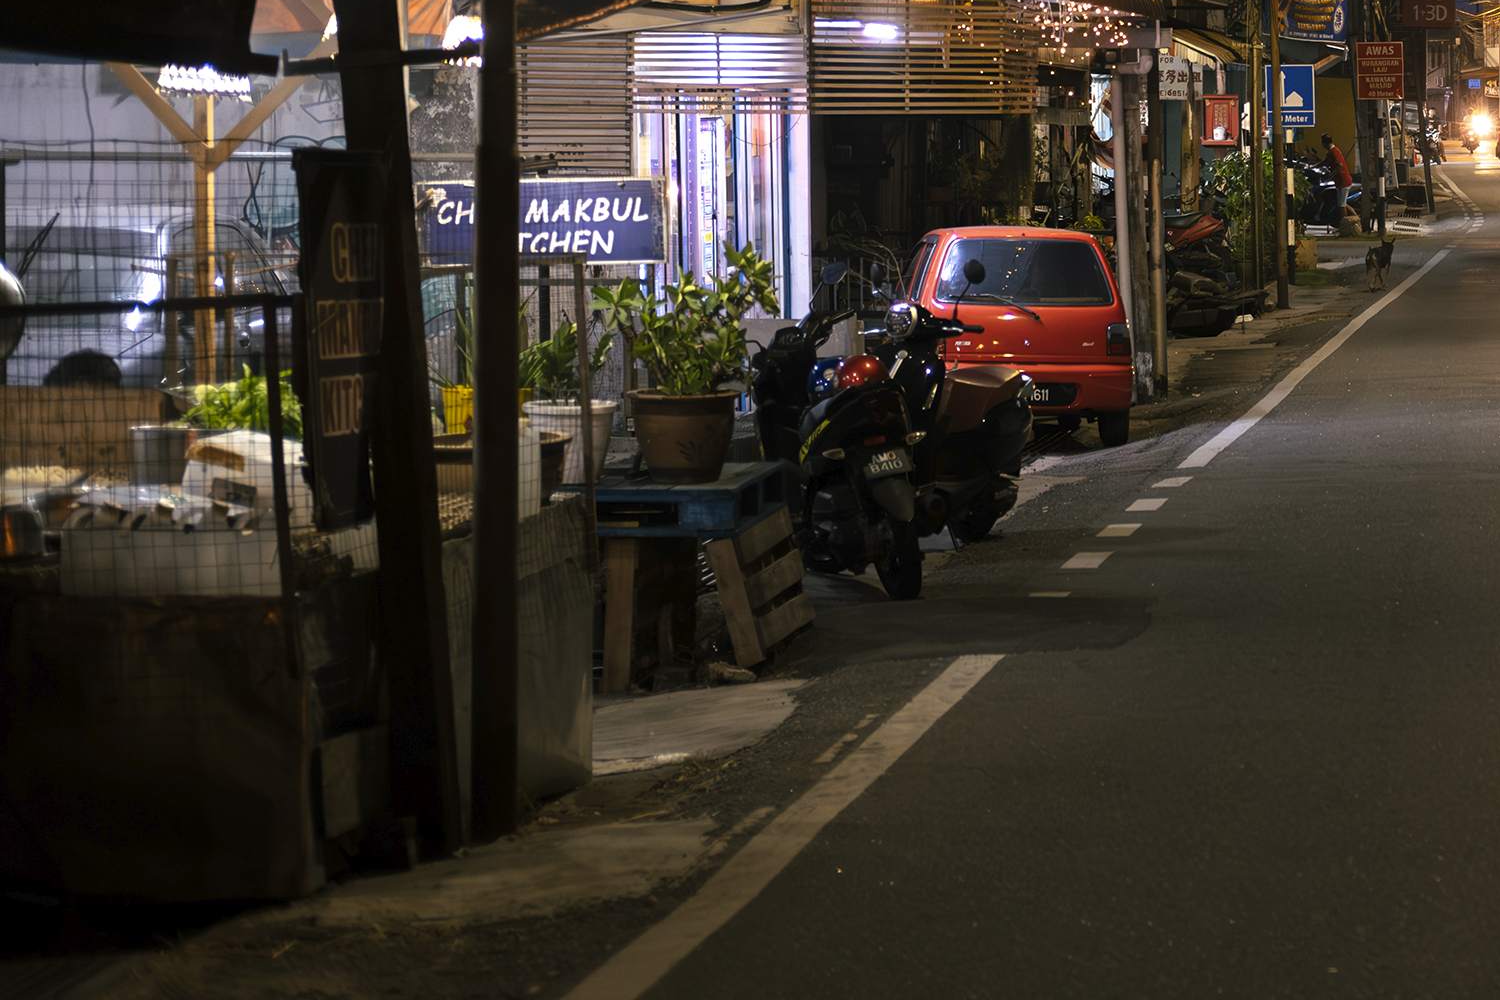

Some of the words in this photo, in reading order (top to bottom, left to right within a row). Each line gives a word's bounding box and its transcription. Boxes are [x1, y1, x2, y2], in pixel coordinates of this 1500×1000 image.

[1412, 4, 1448, 21] 1+3D
[1366, 46, 1395, 56] AWAS
[1285, 115, 1309, 123] Meter
[524, 197, 650, 225] MAKBUL
[869, 459, 903, 474] 8410
